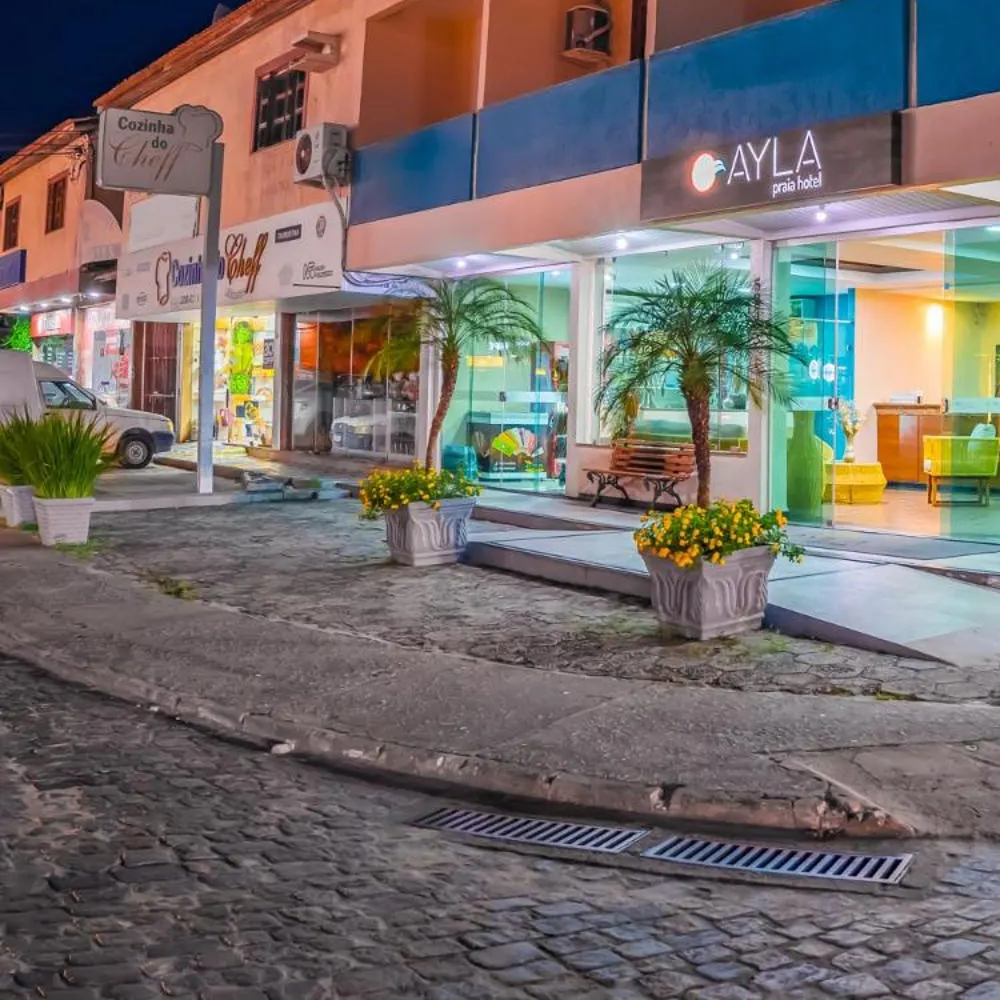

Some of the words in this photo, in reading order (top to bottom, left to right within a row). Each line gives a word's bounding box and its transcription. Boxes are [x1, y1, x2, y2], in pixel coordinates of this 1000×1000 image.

[118, 116, 174, 134] Cozinha
[151, 137, 168, 149] do
[727, 130, 821, 184] AYLA
[772, 178, 796, 198] praia
[797, 171, 822, 190] hotel
[225, 231, 269, 294] Cheff
